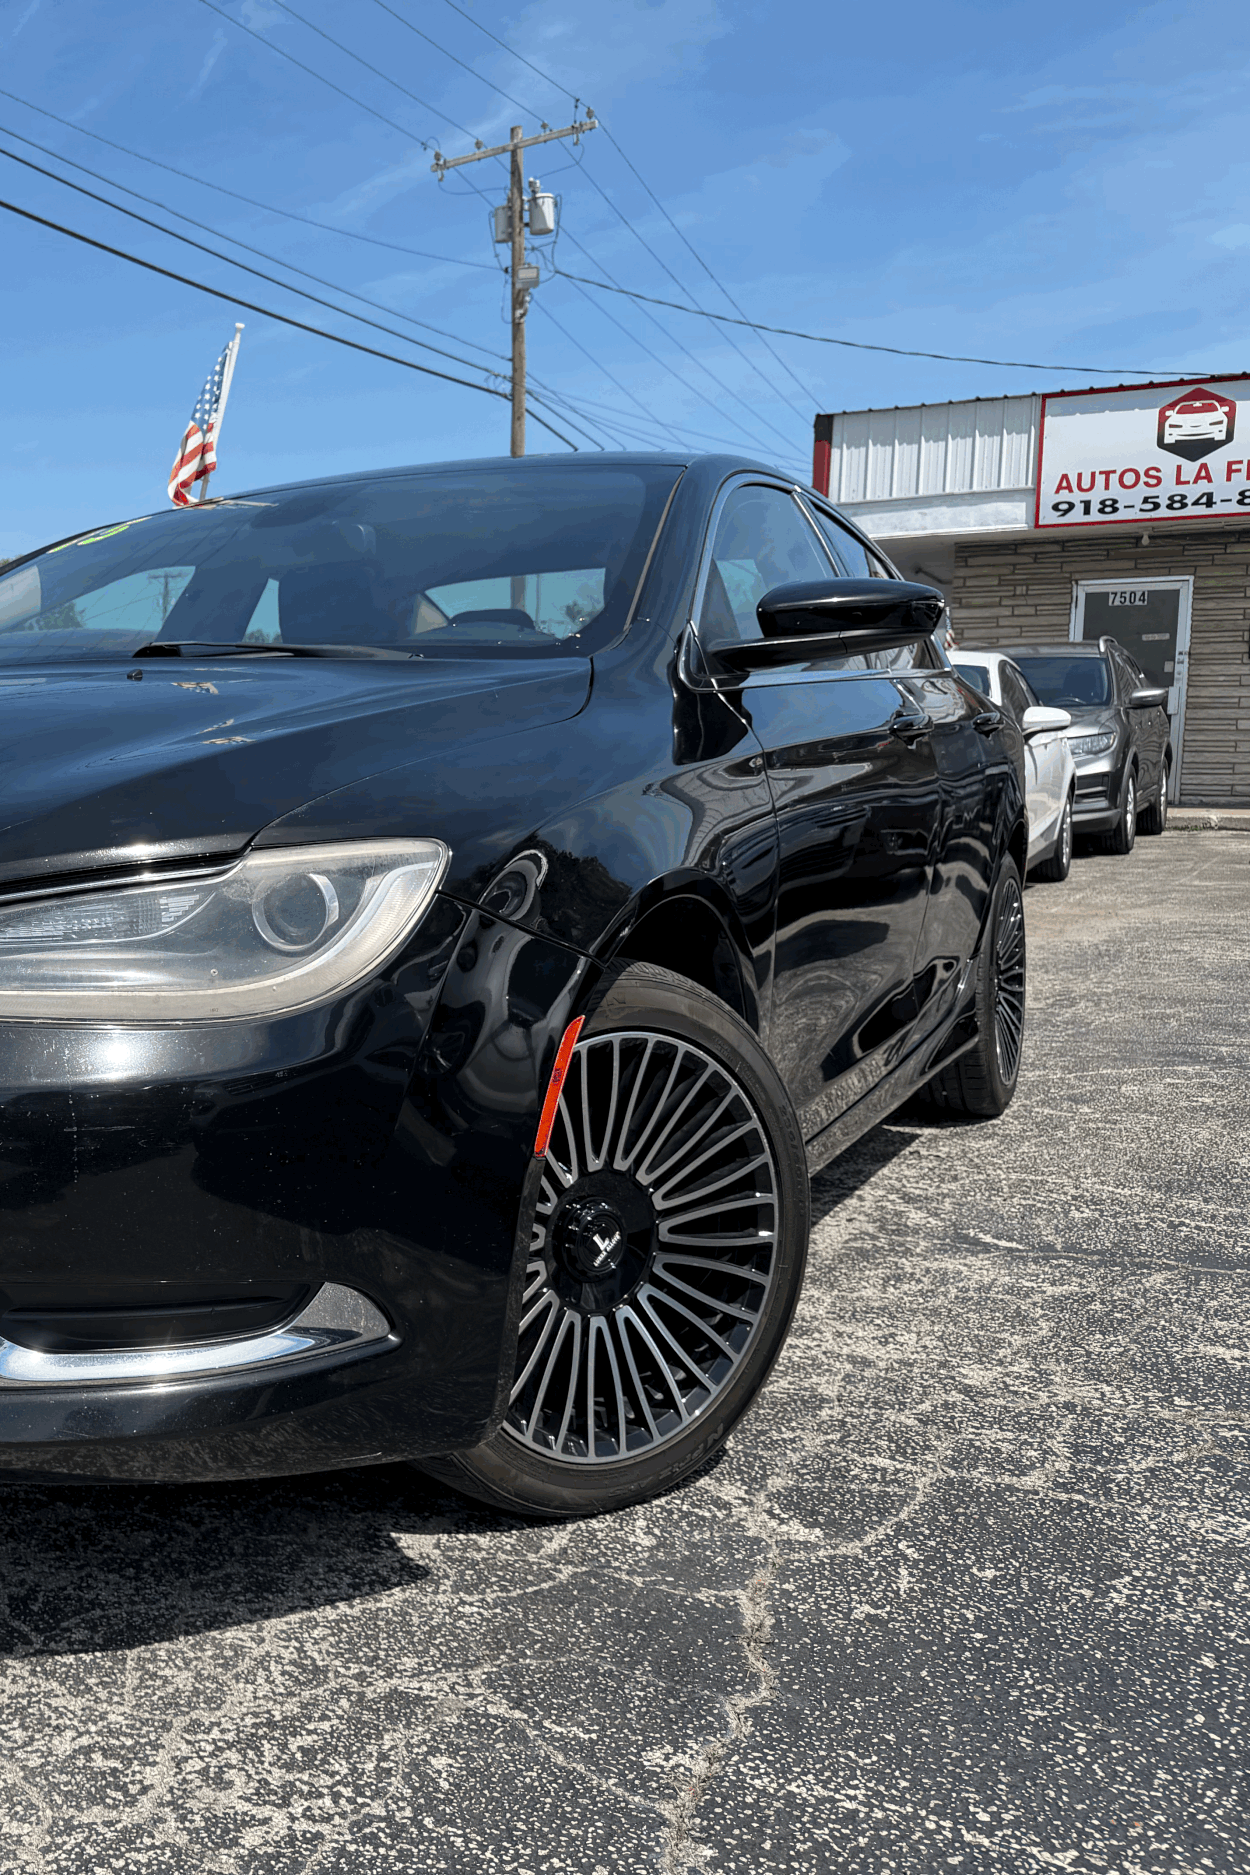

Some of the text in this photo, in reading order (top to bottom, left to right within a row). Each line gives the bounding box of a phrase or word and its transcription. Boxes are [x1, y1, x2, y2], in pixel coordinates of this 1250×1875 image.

[1054, 466, 1163, 495] AUTOS
[1175, 462, 1214, 486] LA
[1110, 591, 1147, 606] 7504
